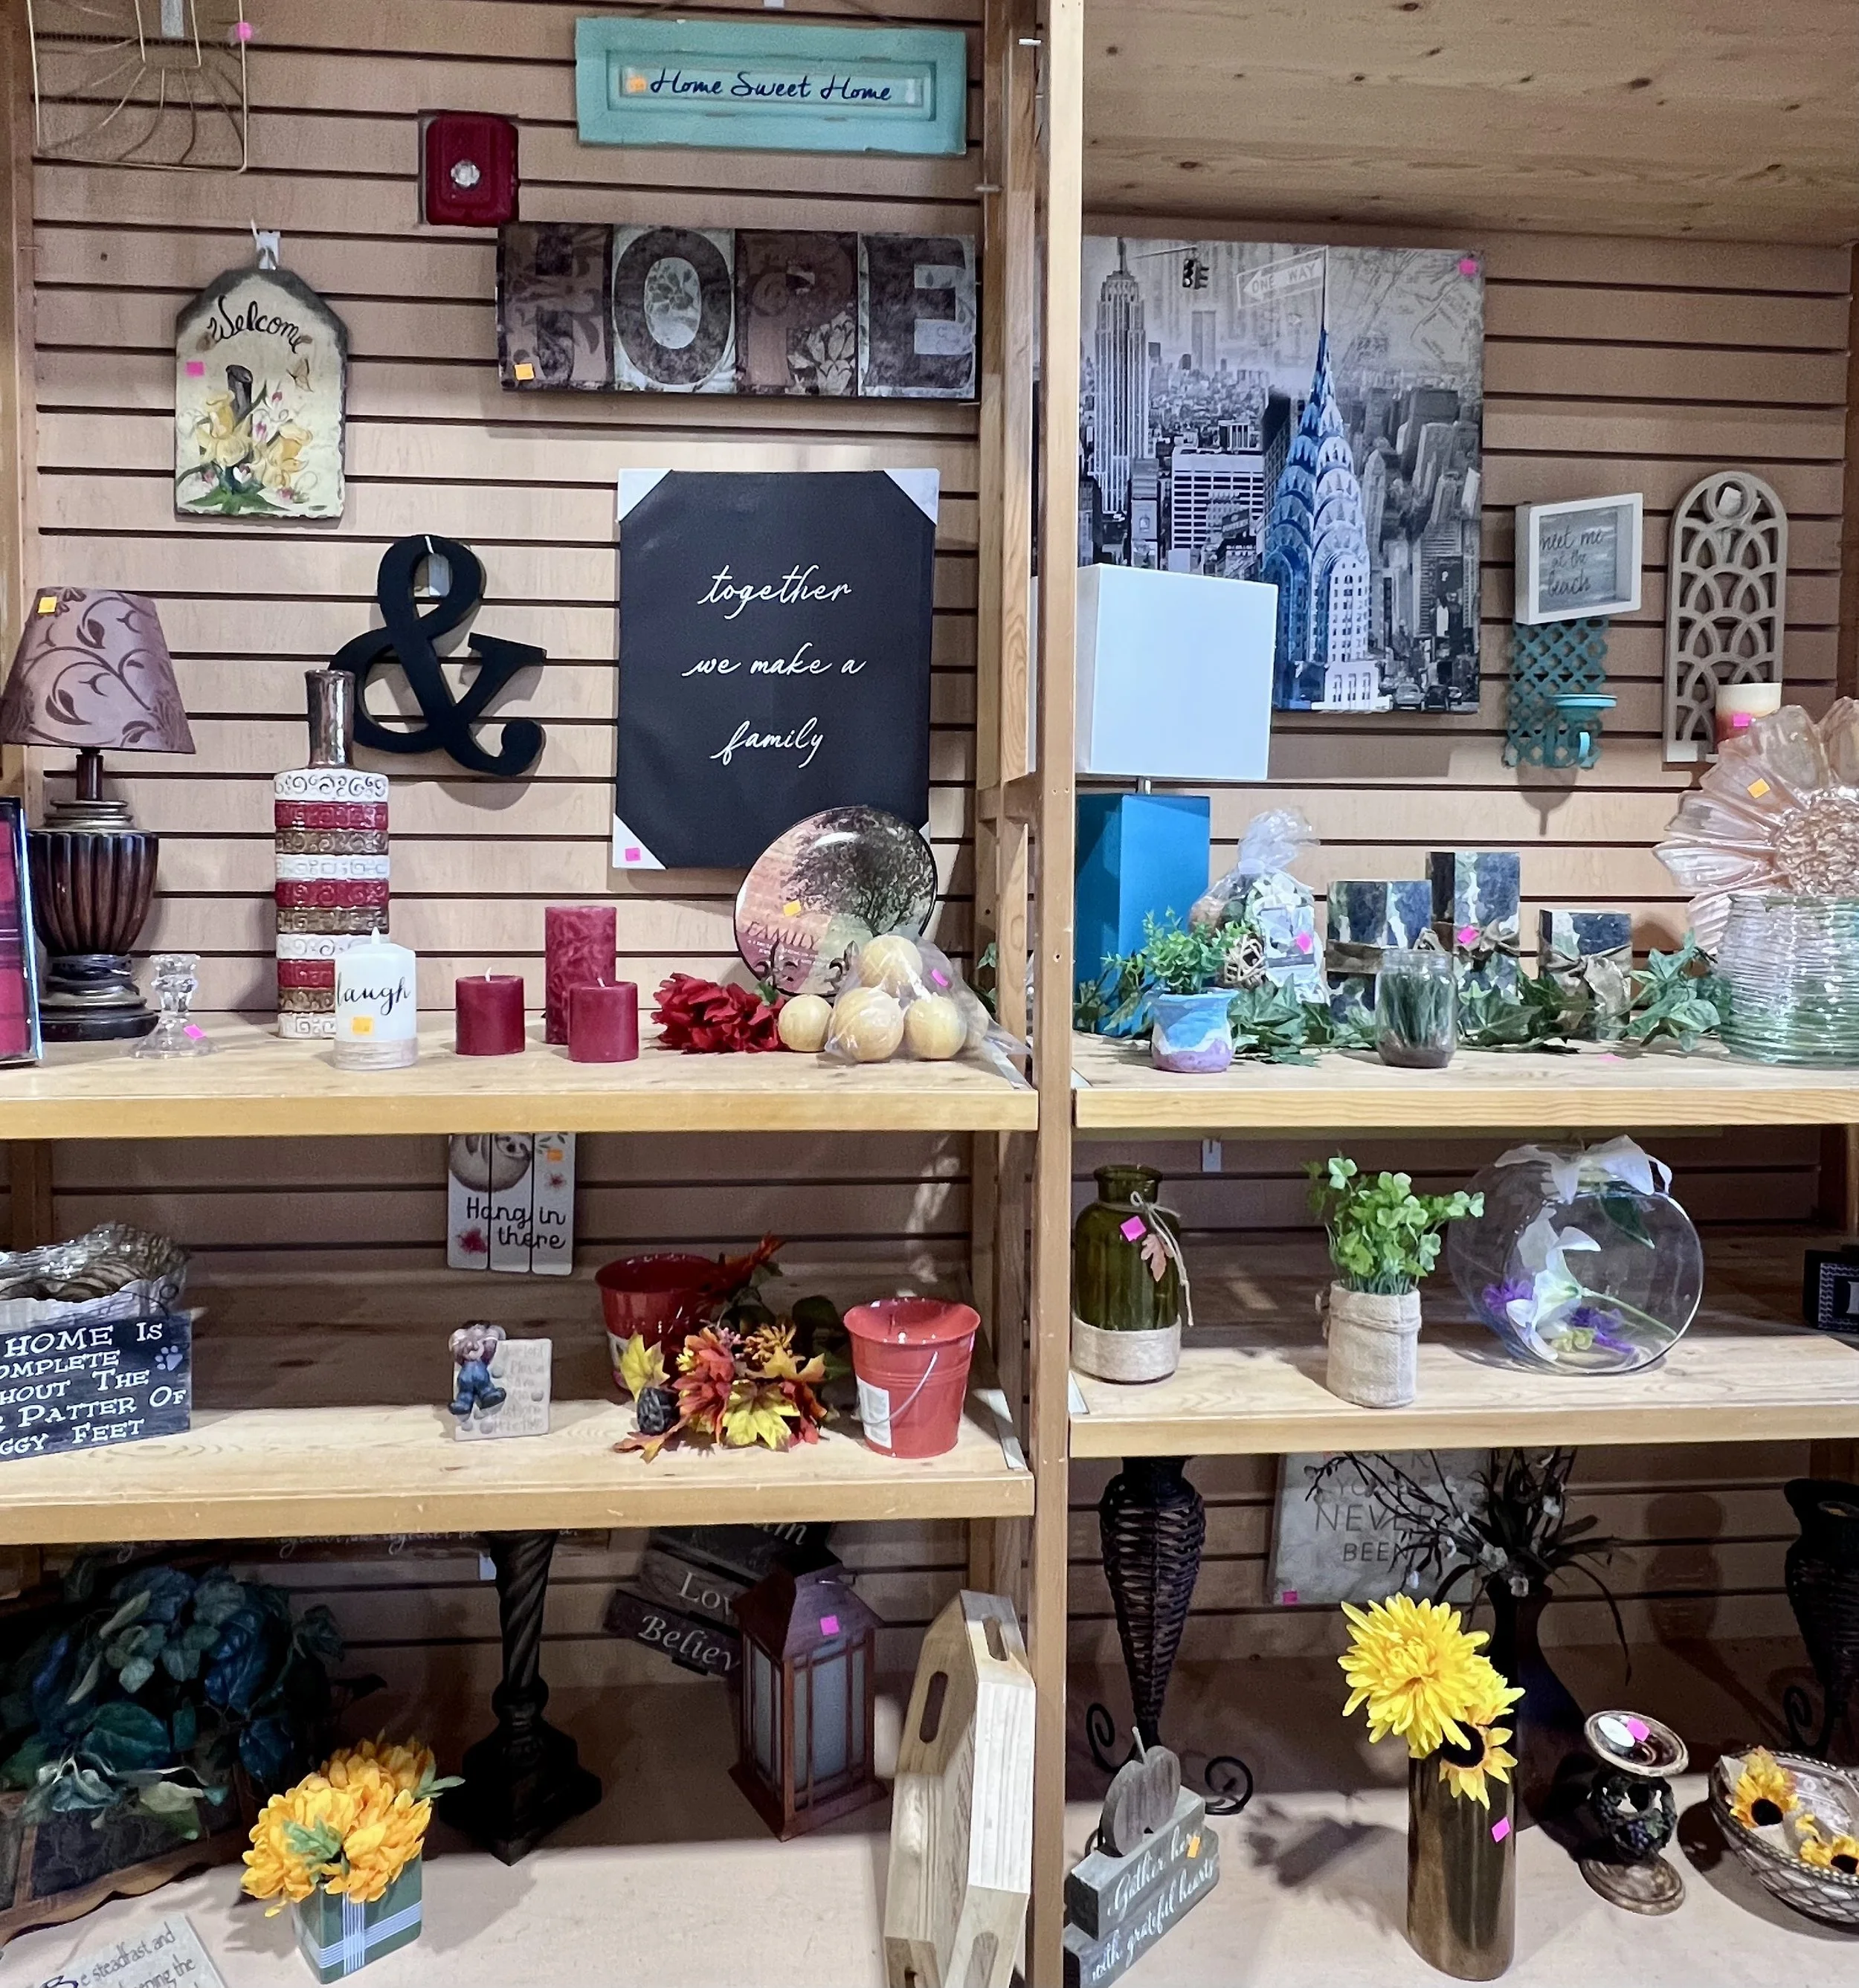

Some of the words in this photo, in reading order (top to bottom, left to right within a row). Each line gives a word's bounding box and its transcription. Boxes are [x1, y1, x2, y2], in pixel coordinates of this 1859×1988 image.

[651, 68, 723, 95] Home
[730, 71, 811, 97] Sweet
[819, 74, 892, 102] Home
[1251, 274, 1276, 294] ONE
[1285, 261, 1320, 288] WAY
[500, 225, 973, 387] HOPE
[207, 294, 305, 354] Welcome
[697, 564, 852, 620] together
[681, 653, 741, 677] we
[750, 642, 833, 675] make
[840, 659, 867, 675] a
[709, 717, 824, 769] family
[744, 920, 822, 952] FAMILY
[337, 972, 411, 1016] laugh
[466, 1196, 532, 1230] Hang
[539, 1206, 566, 1225] in
[497, 1225, 566, 1250] there
[3, 1325, 114, 1358] HOME
[1314, 1503, 1437, 1532] NEVER
[637, 1614, 741, 1671] Believ
[92, 1940, 152, 1978] steadfast
[153, 1920, 176, 1951] and
[172, 1953, 196, 1978] the
